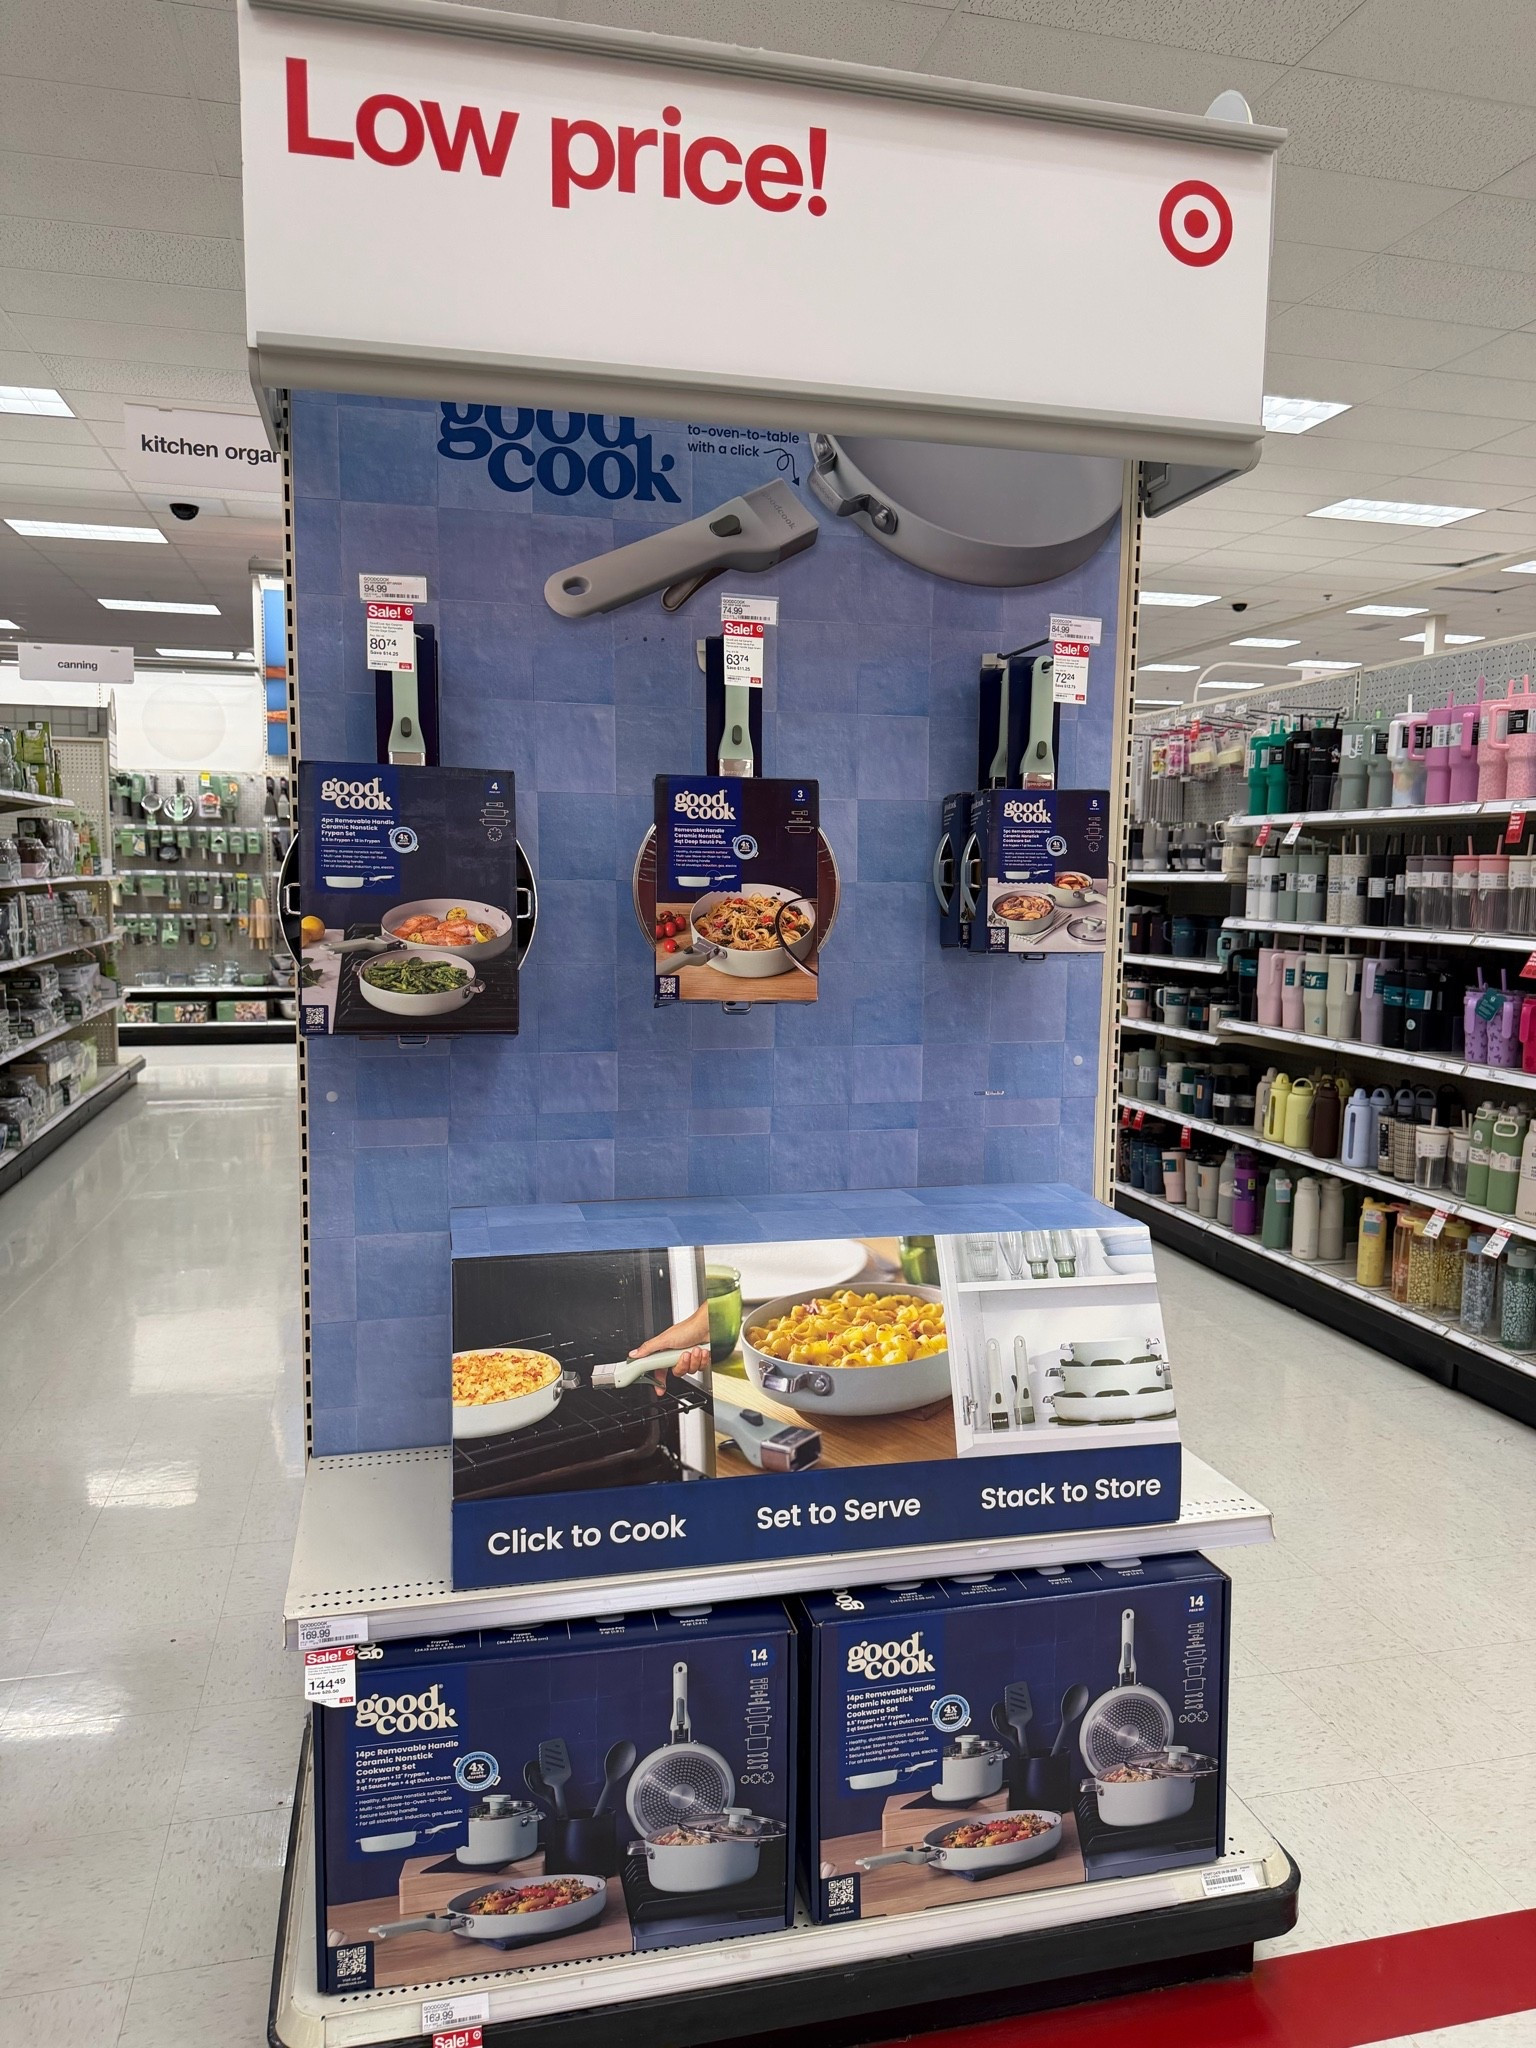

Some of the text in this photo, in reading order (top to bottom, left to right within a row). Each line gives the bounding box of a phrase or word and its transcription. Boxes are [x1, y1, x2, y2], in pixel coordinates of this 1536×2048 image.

[285, 57, 827, 216] Low price!
[688, 425, 799, 443] to-oven-to-table
[141, 434, 218, 458] kitchen
[688, 441, 760, 457] with a click
[488, 434, 681, 503] cook
[364, 585, 387, 593] 94.99
[368, 605, 401, 618] Sale!
[723, 606, 743, 614] 74.99
[725, 622, 753, 635] Sale!
[1055, 643, 1080, 655] Sale!
[57, 660, 98, 671] canning
[321, 777, 379, 800] good
[491, 782, 498, 790] 4
[336, 792, 393, 810] cook
[674, 789, 725, 812] good
[798, 790, 803, 798] 3
[686, 803, 736, 820] cook
[1004, 799, 1044, 817] good
[1013, 809, 1052, 823] cook
[741, 841, 750, 849] 4x
[981, 1475, 1161, 1511] Stack to Store
[756, 1496, 921, 1532] Set to Serve
[488, 1514, 687, 1555] Click to Cook
[1189, 1595, 1204, 1608] 14
[300, 1629, 330, 1640] 169.99
[306, 1650, 342, 1664] Sale!
[751, 1649, 768, 1662] 14
[847, 1631, 919, 1673] good
[864, 1648, 936, 1680] cook
[865, 1688, 908, 1700] Removable
[909, 1684, 936, 1694] Handle
[356, 1684, 439, 1727] good
[847, 1695, 913, 1710] Ceramic Nonstick
[944, 1705, 958, 1714] 4x
[376, 1703, 459, 1735] cook
[847, 1708, 885, 1718] Cookware
[872, 1737, 929, 1749] Stove-to-Oven-to-Table
[356, 1741, 459, 1760] 14pc Removable Handle
[356, 1752, 433, 1767] Ceramic Nonstick
[356, 1765, 400, 1776] Cookware
[469, 1762, 485, 1772] 4x
[369, 1776, 390, 1784] Frypan
[359, 1791, 426, 1805] Healthy, durable nonstick
[359, 1796, 452, 1812] Multi-use: Stove-to-Oven-to-Table
[376, 1816, 404, 1824] stovetops:
[404, 1812, 431, 1820] induction,
[378, 1810, 398, 1818] locking
[424, 2010, 453, 2023] 169.99
[435, 2032, 469, 2048] Sale!
